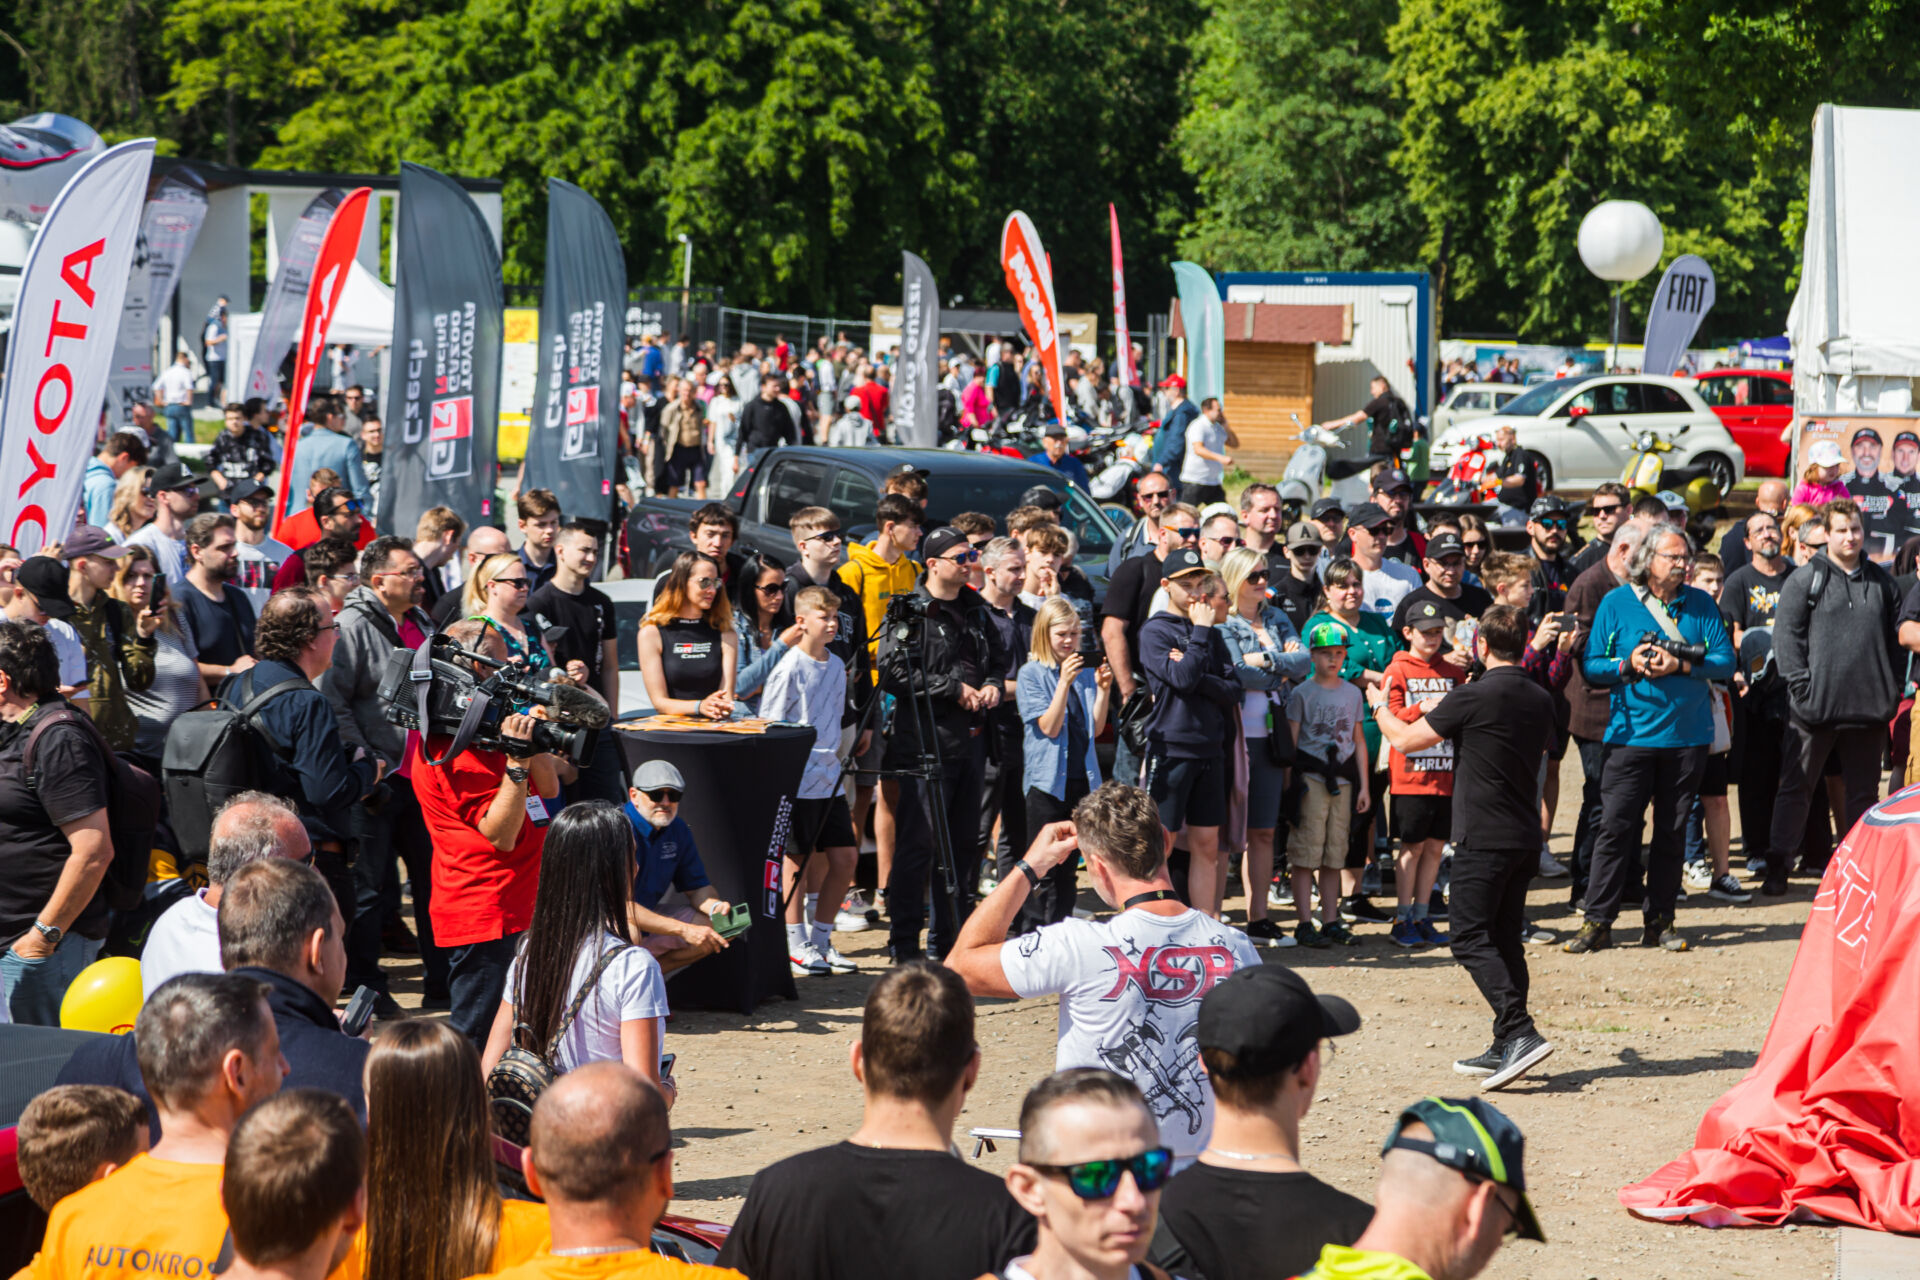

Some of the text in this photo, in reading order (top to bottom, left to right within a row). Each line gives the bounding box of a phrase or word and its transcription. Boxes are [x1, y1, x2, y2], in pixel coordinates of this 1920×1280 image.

[1666, 273, 1708, 315] FIAT
[1300, 525, 1312, 538] A
[1407, 678, 1454, 692] SKATE
[768, 864, 780, 915] GR
